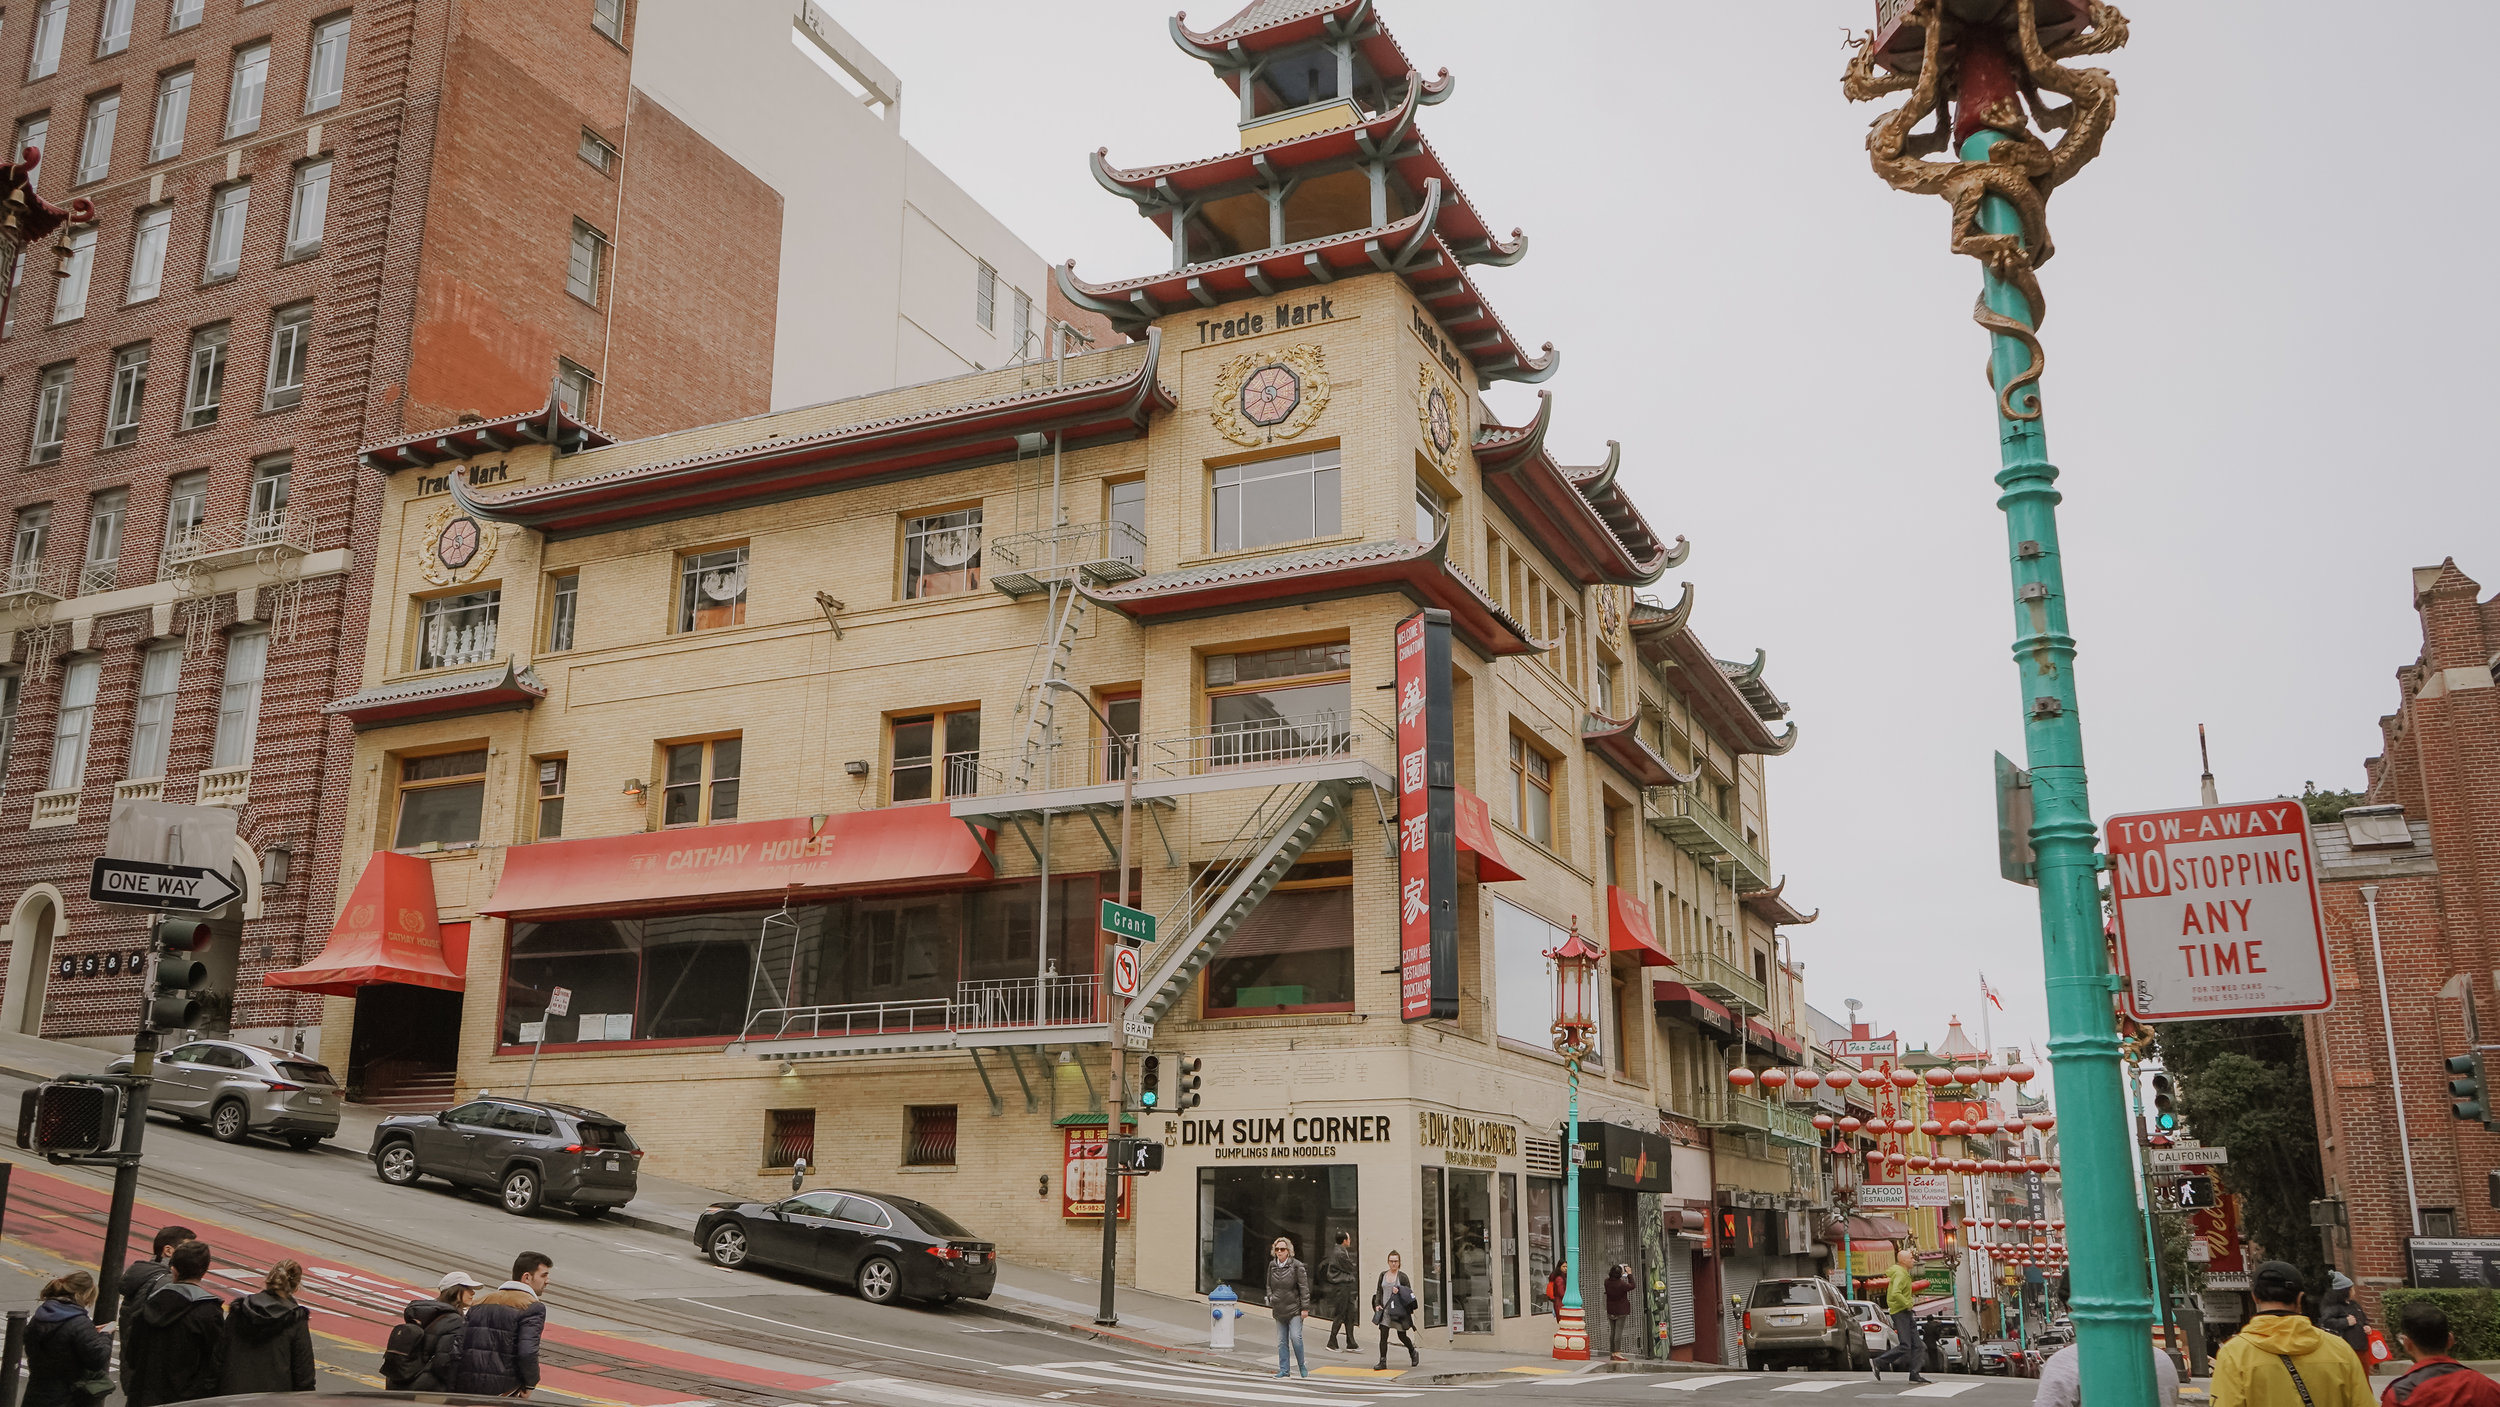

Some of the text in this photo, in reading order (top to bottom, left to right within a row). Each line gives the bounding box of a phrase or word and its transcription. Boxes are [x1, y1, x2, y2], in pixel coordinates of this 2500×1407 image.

[1197, 296, 1333, 344] Trade Mark
[1412, 304, 1463, 383] Trade Mark
[417, 460, 508, 496] Trad Mark
[1397, 626, 1417, 646] WELCOME
[1399, 635, 1425, 662] CHINATOWN
[2119, 808, 2288, 844] TOW-AWAY
[666, 843, 751, 871] CATHAY
[759, 834, 836, 862] HOUSE
[2116, 848, 2300, 895] NO STOPPING
[109, 872, 200, 896] ONE WAY
[1113, 911, 1146, 934] Grant
[2182, 899, 2252, 936] ANY
[388, 931, 441, 948] CATHAY HOUSE
[1403, 943, 1431, 964] CATHAY HOUSE
[2178, 940, 2267, 978] TIME
[1403, 960, 1431, 981] RESTAURANT
[1403, 981, 1427, 999] COCKTAILS
[2192, 983, 2263, 993] FOR TOWED CARS
[2192, 994, 2219, 1003] PHONE
[1125, 1022, 1152, 1036] GRANT
[1849, 1042, 1892, 1051] Far East
[1182, 1115, 1391, 1145] DIM SUM CORNER
[1428, 1112, 1517, 1157] DIM SUM CORNER
[1215, 1146, 1336, 1159] DUMPLINGS AND NOODLES
[2158, 1150, 2221, 1162] CALIFORNIA
[1974, 1178, 1982, 1210] Bank
